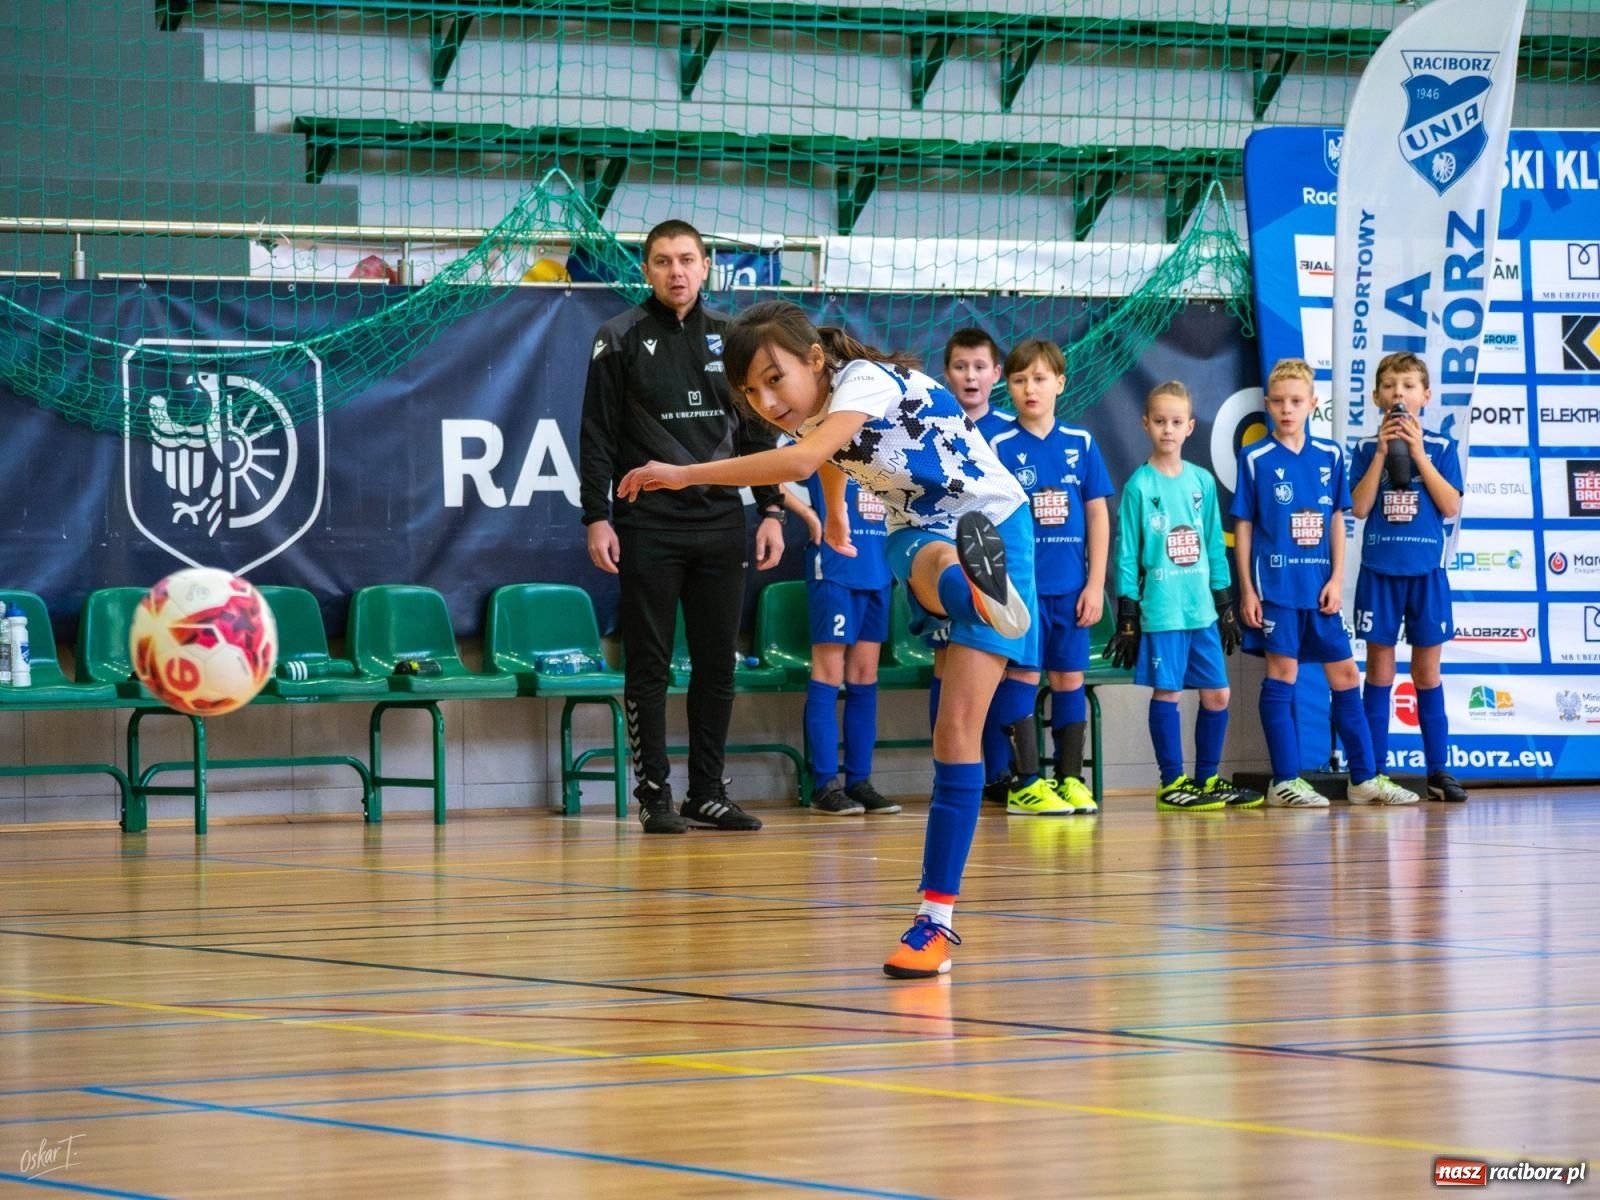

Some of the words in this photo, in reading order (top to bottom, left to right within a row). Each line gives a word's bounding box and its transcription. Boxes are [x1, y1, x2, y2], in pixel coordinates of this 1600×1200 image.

[1412, 57, 1491, 71] RACIBORZ
[1416, 88, 1440, 100] 1946
[1406, 102, 1479, 150] UNIA
[1556, 150, 1600, 189] KL
[1352, 209, 1375, 350] SPORTOWY
[1347, 359, 1366, 426] KLUB
[1541, 408, 1600, 423] ELEKTR
[1575, 477, 1600, 490] BEE
[1033, 495, 1068, 508] BEEF
[1384, 494, 1419, 505] BEEF
[1576, 490, 1600, 501] BRO
[1034, 506, 1068, 518] BROS
[1384, 504, 1417, 515] BROS
[1291, 517, 1324, 528] BEEF
[1292, 527, 1323, 538] BROS
[1167, 534, 1199, 547] BEEF
[1168, 545, 1200, 557] BROS
[833, 613, 846, 636] 2
